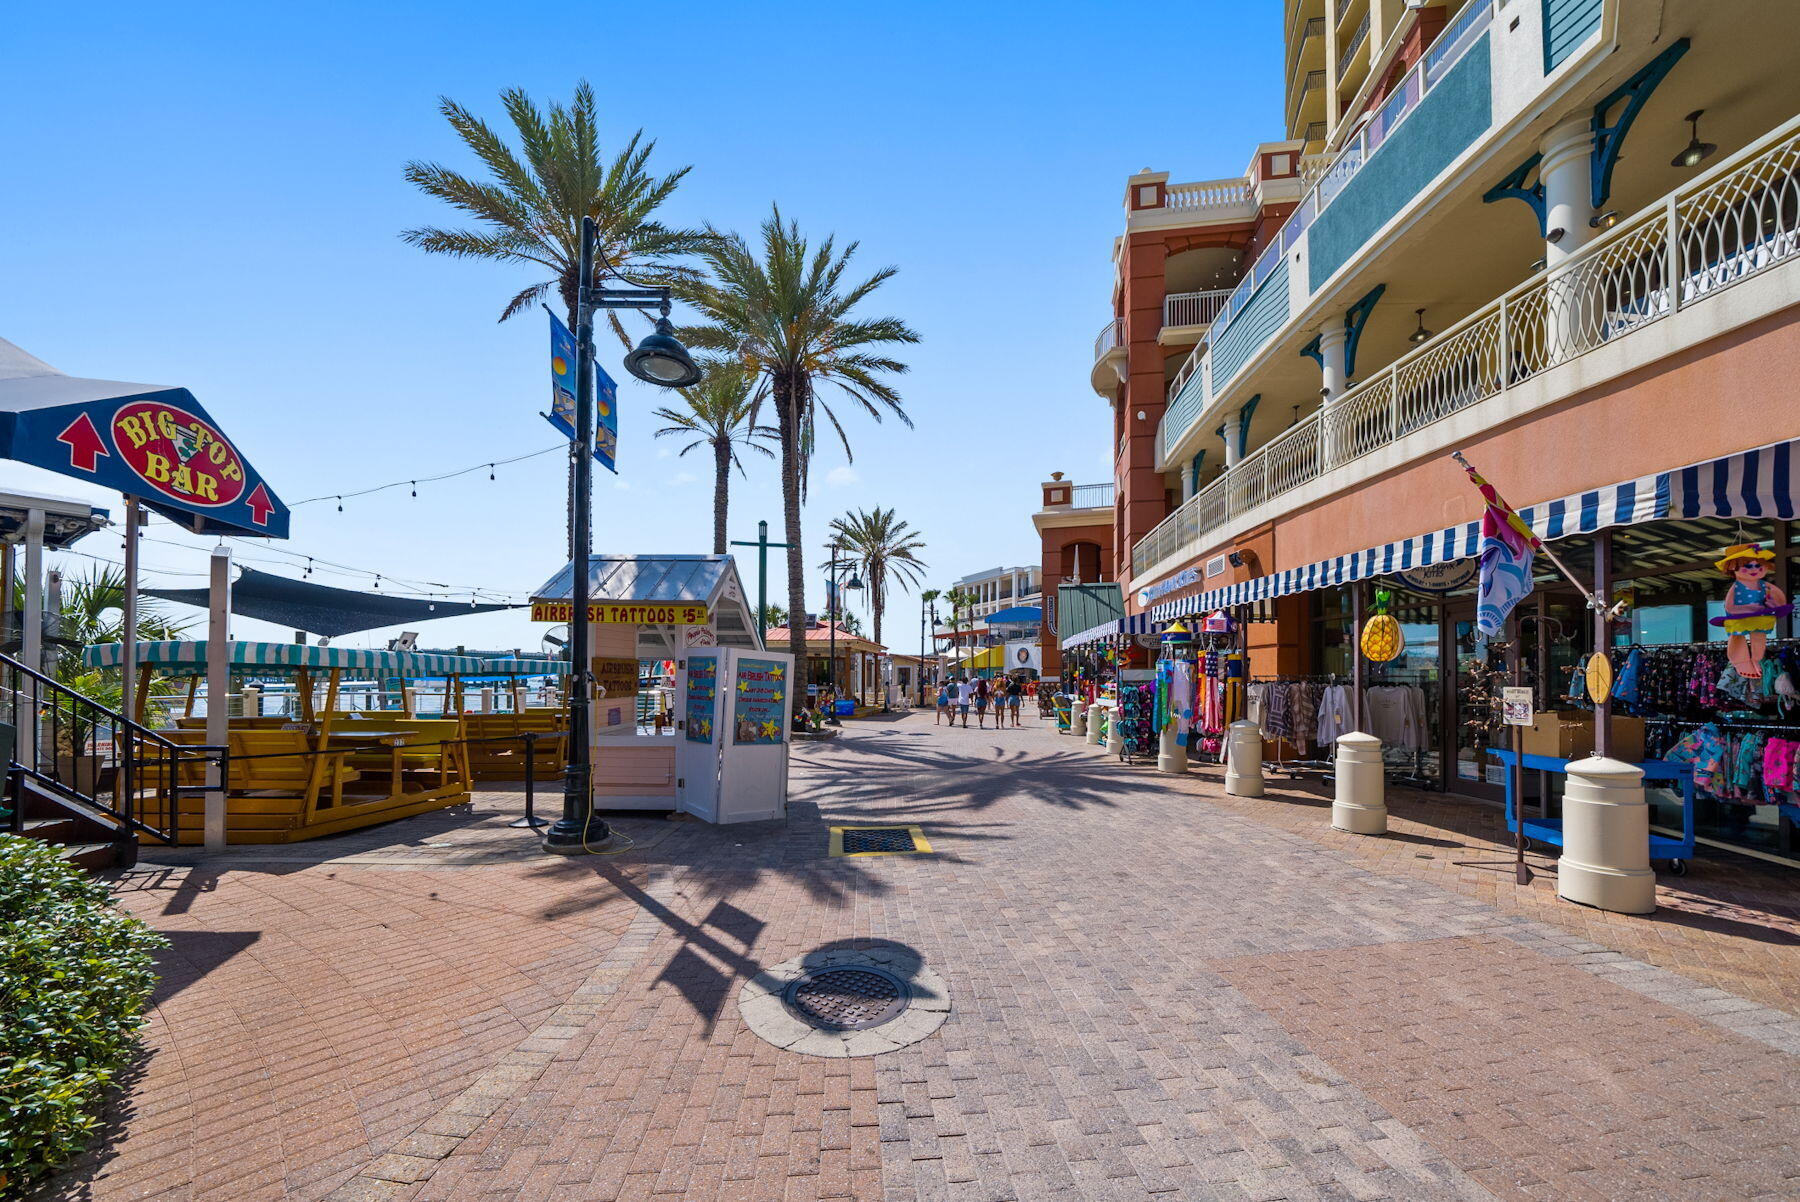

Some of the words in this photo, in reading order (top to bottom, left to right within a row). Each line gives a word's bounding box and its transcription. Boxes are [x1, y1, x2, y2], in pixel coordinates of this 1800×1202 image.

[116, 410, 178, 449] BIG
[189, 422, 242, 482] TOP
[144, 450, 219, 501] BAR
[1423, 570, 1444, 578] KITES
[611, 607, 675, 623] TATTOOS
